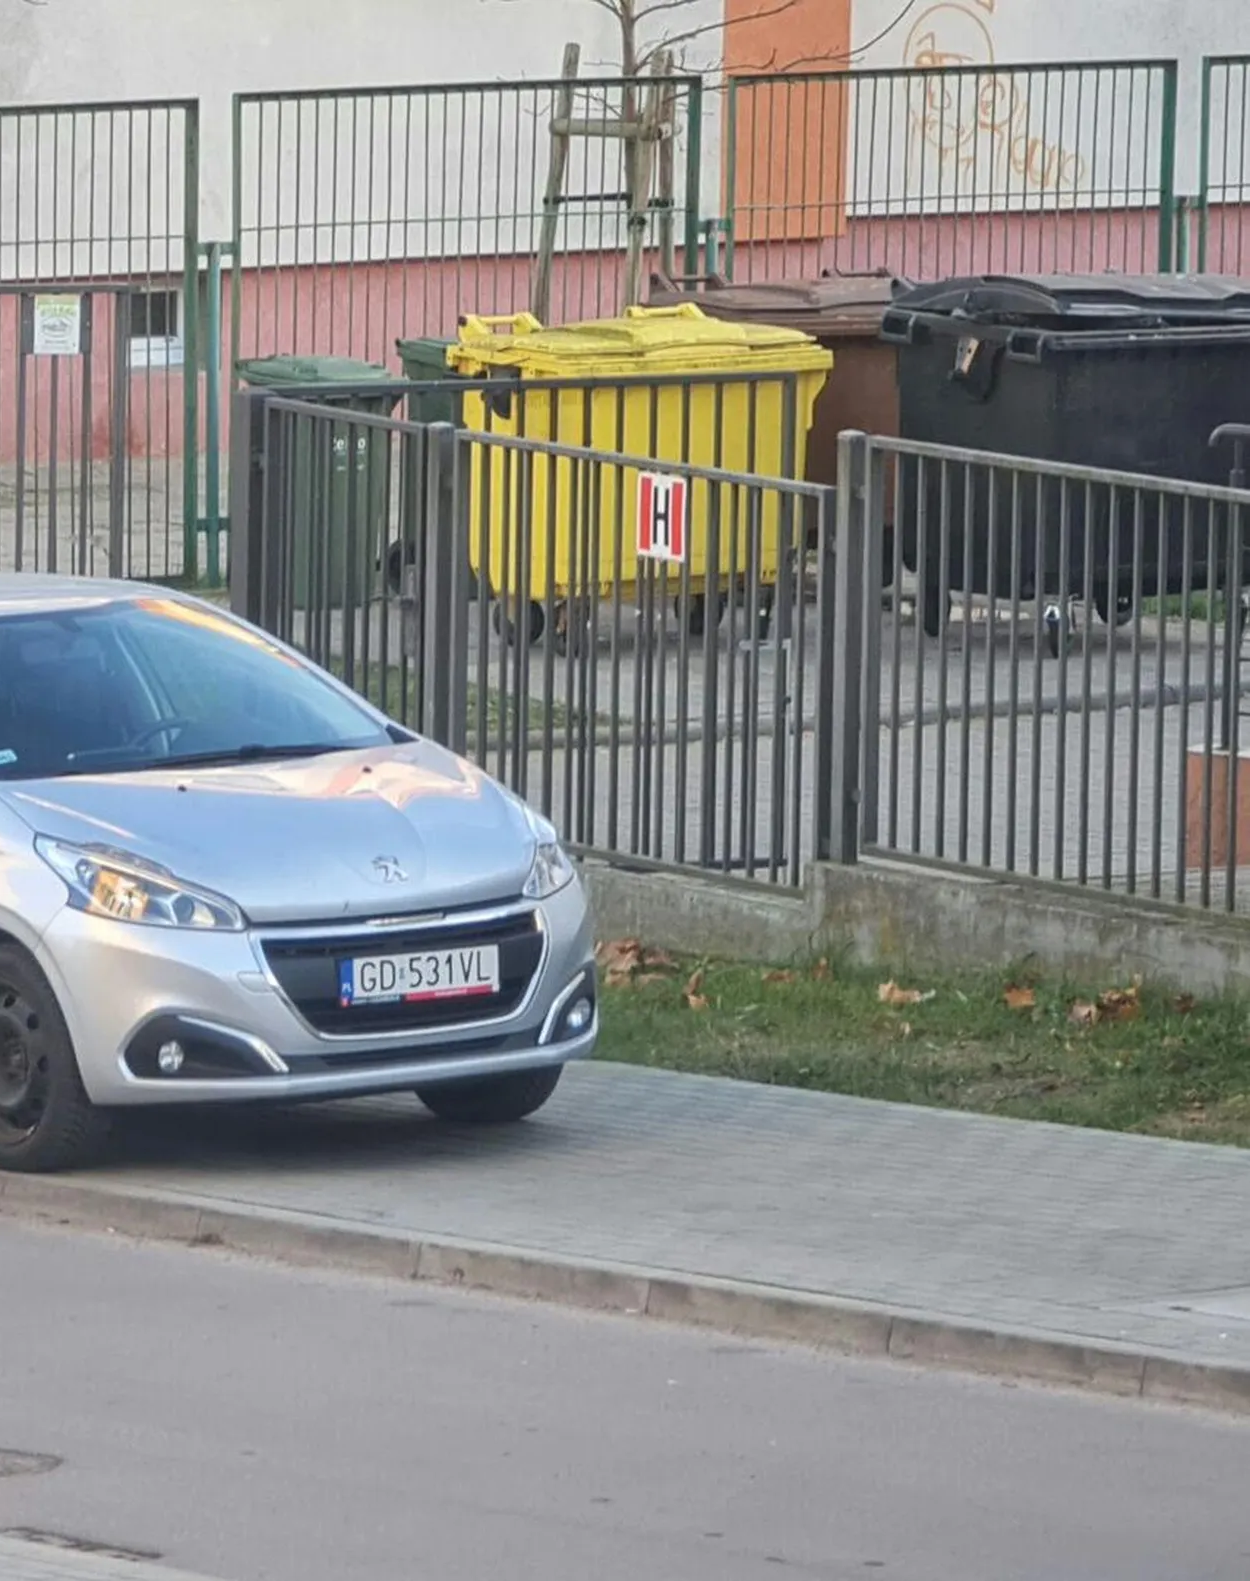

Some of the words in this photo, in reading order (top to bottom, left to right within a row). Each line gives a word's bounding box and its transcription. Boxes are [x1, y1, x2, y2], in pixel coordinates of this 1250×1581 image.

[653, 486, 669, 547] H
[360, 960, 396, 992] GD
[408, 951, 491, 988] 531VL
